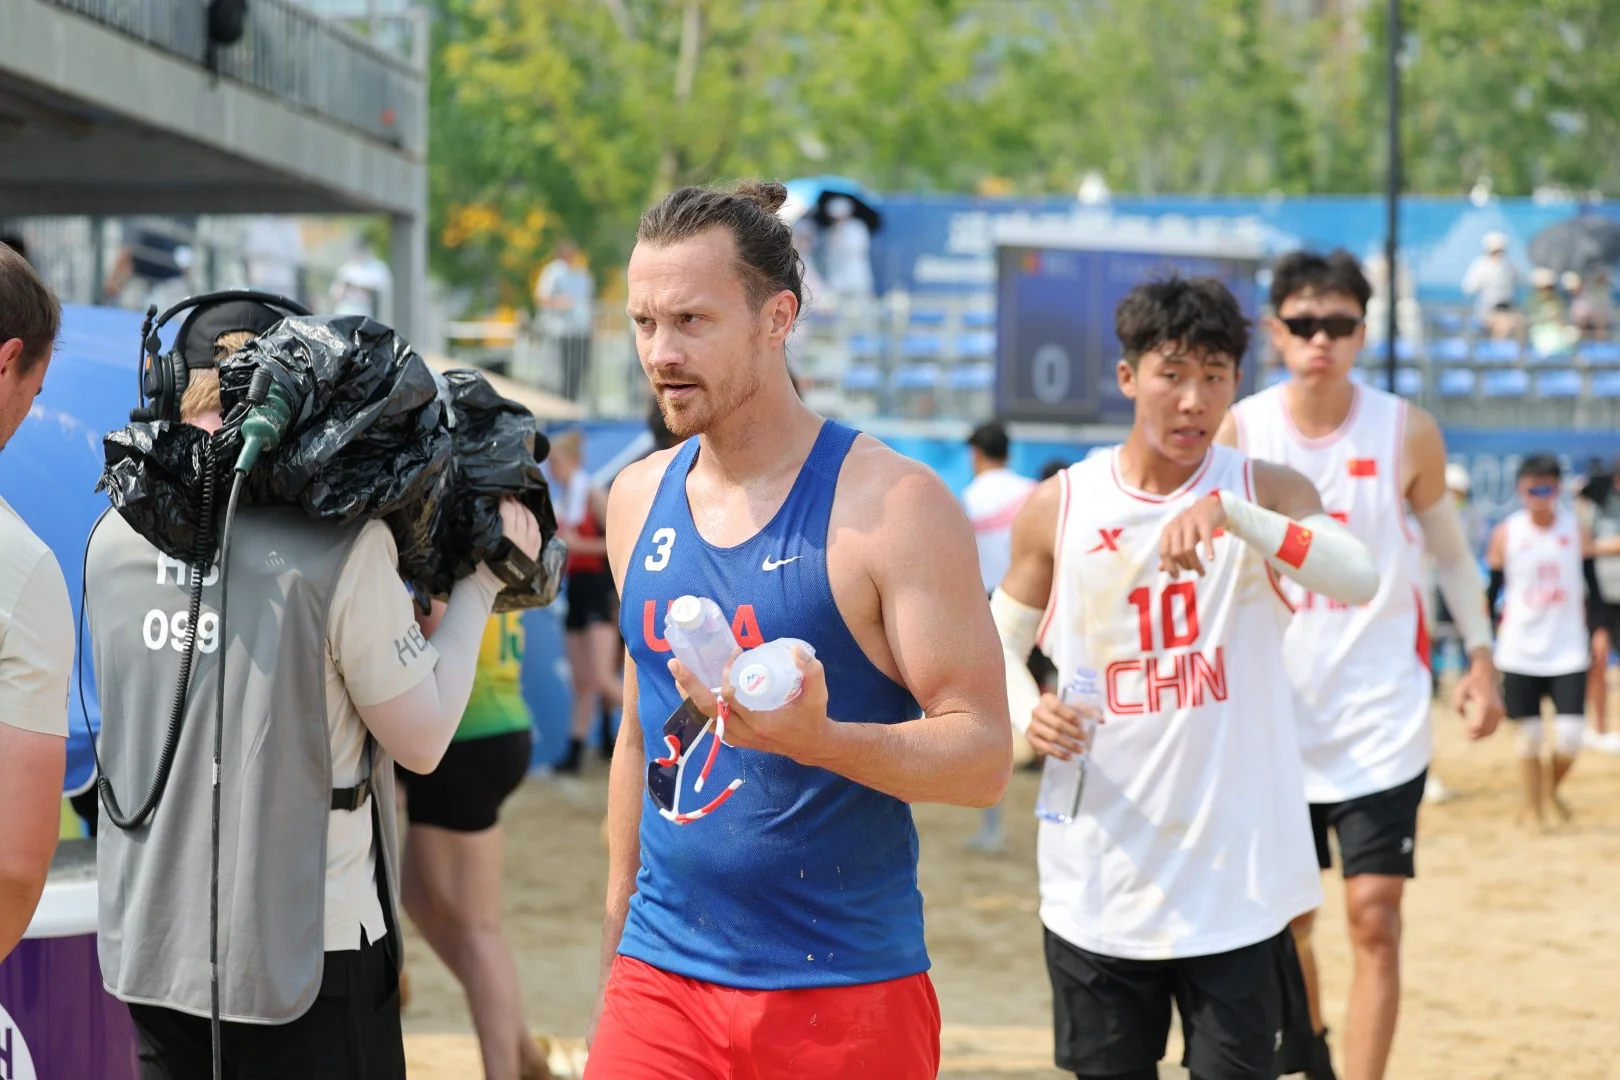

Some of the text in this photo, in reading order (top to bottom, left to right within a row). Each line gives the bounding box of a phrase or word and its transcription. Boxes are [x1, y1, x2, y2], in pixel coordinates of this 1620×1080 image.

[645, 528, 676, 572] 3
[142, 609, 220, 654] 099
[643, 600, 765, 652] UA
[1128, 581, 1199, 652] 10
[1106, 646, 1228, 715] CHN
